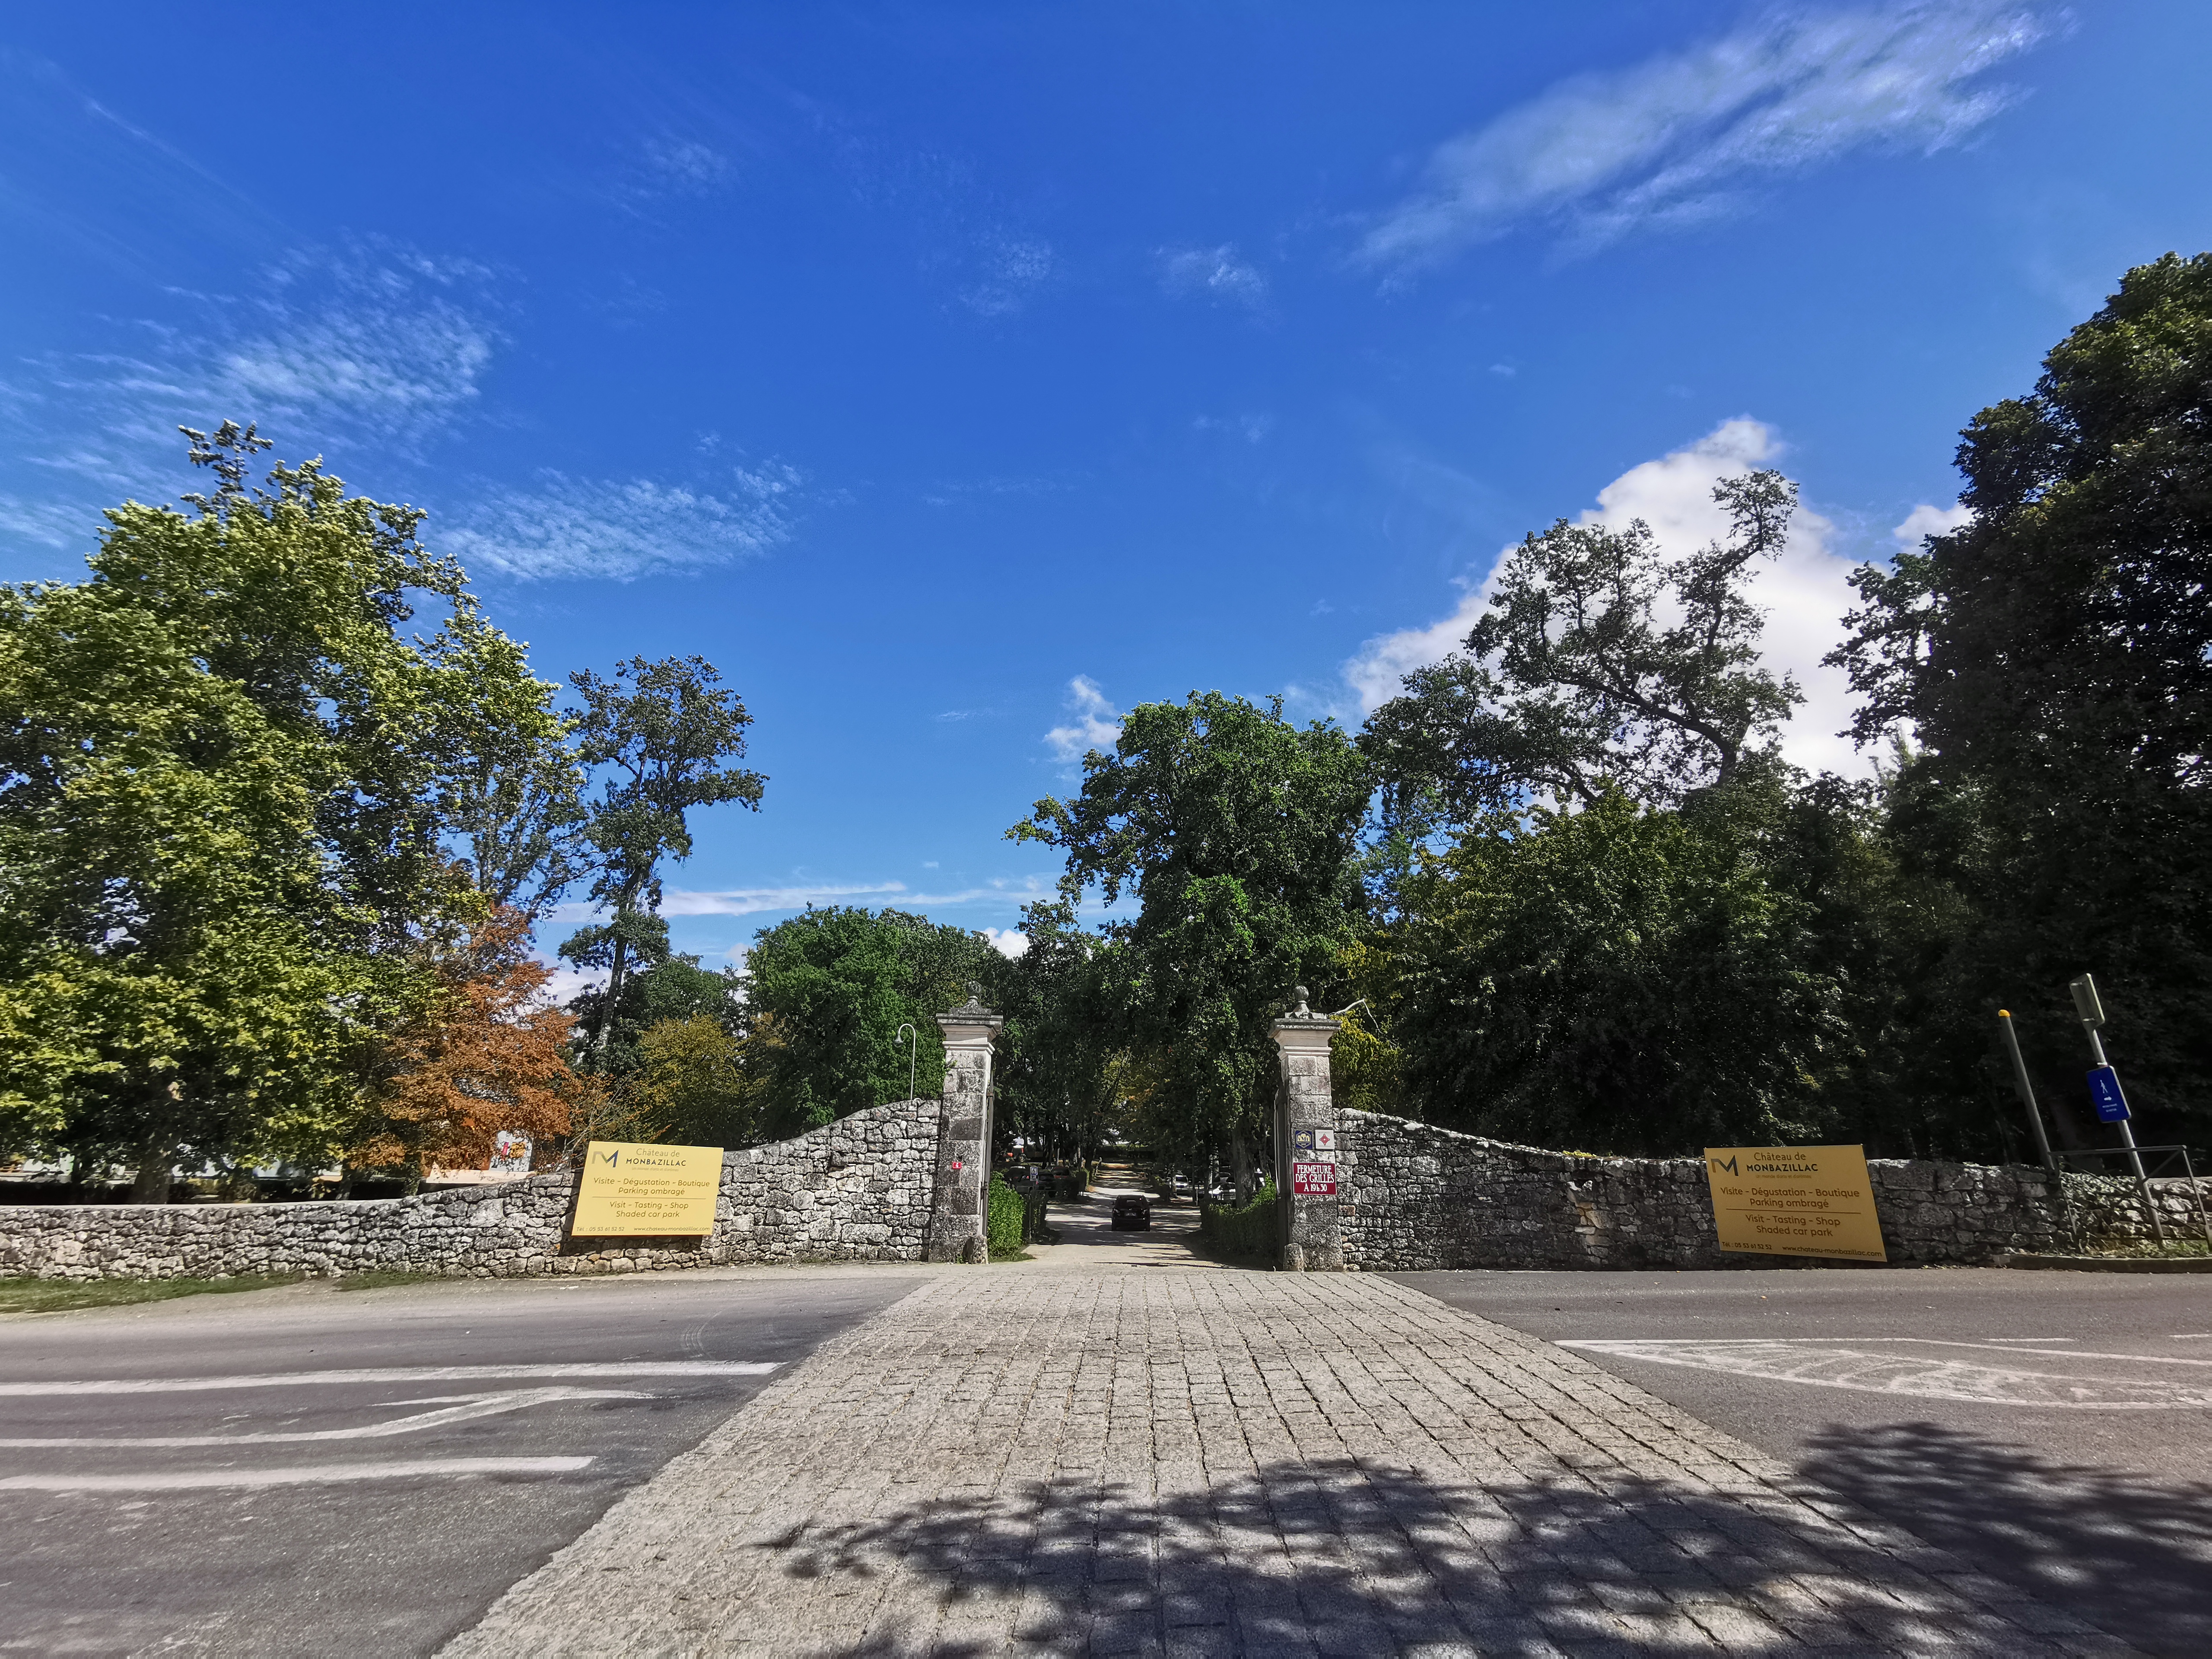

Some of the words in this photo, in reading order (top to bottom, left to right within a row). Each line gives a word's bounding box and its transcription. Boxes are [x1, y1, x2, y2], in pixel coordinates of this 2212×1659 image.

[1754, 1152, 1791, 1161] Château
[1297, 1165, 1332, 1174] FERMETURE
[623, 1178, 670, 1186] Dégustation
[1296, 1174, 1307, 1182] DES
[1309, 1174, 1334, 1183] GRILLES
[1751, 1188, 1806, 1196] Dégustation
[1816, 1189, 1859, 1198] Boutique
[1750, 1198, 1783, 1208] Parking
[1786, 1199, 1829, 1209] ombragé
[1773, 1215, 1806, 1225] Tasting
[1816, 1217, 1840, 1227] Shop
[1756, 1226, 1790, 1234] Shaded
[1811, 1228, 1833, 1236] park
[1782, 1246, 1882, 1257] www.chateau-monbazillac.com
